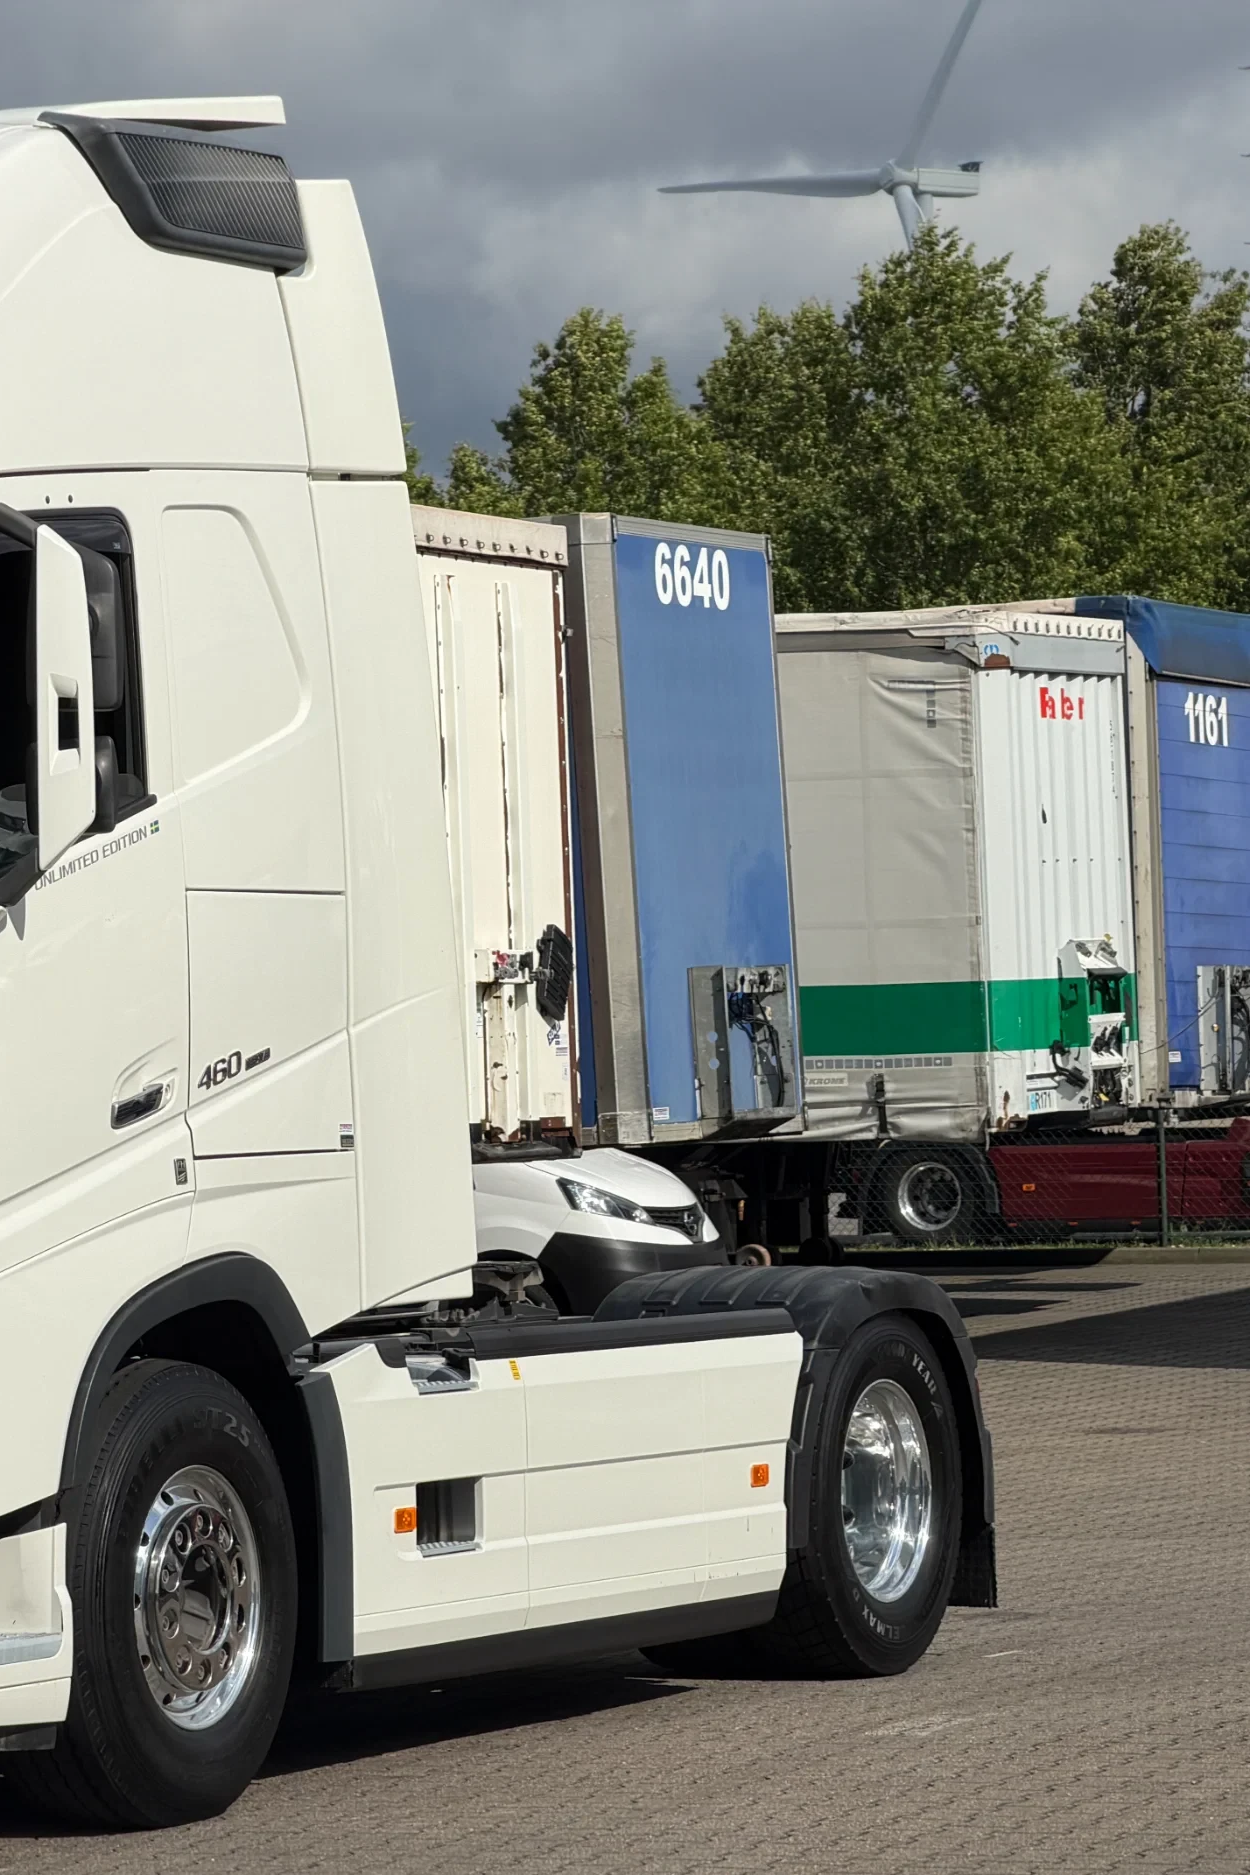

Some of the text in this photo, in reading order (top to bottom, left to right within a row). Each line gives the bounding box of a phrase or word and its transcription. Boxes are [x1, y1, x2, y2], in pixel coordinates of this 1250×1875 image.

[655, 542, 730, 611] 6640
[1184, 692, 1229, 747] 1161
[35, 825, 148, 891] UNLIMITED EDITION
[198, 1050, 242, 1090] 460
[862, 1604, 902, 1641] ELMAX
